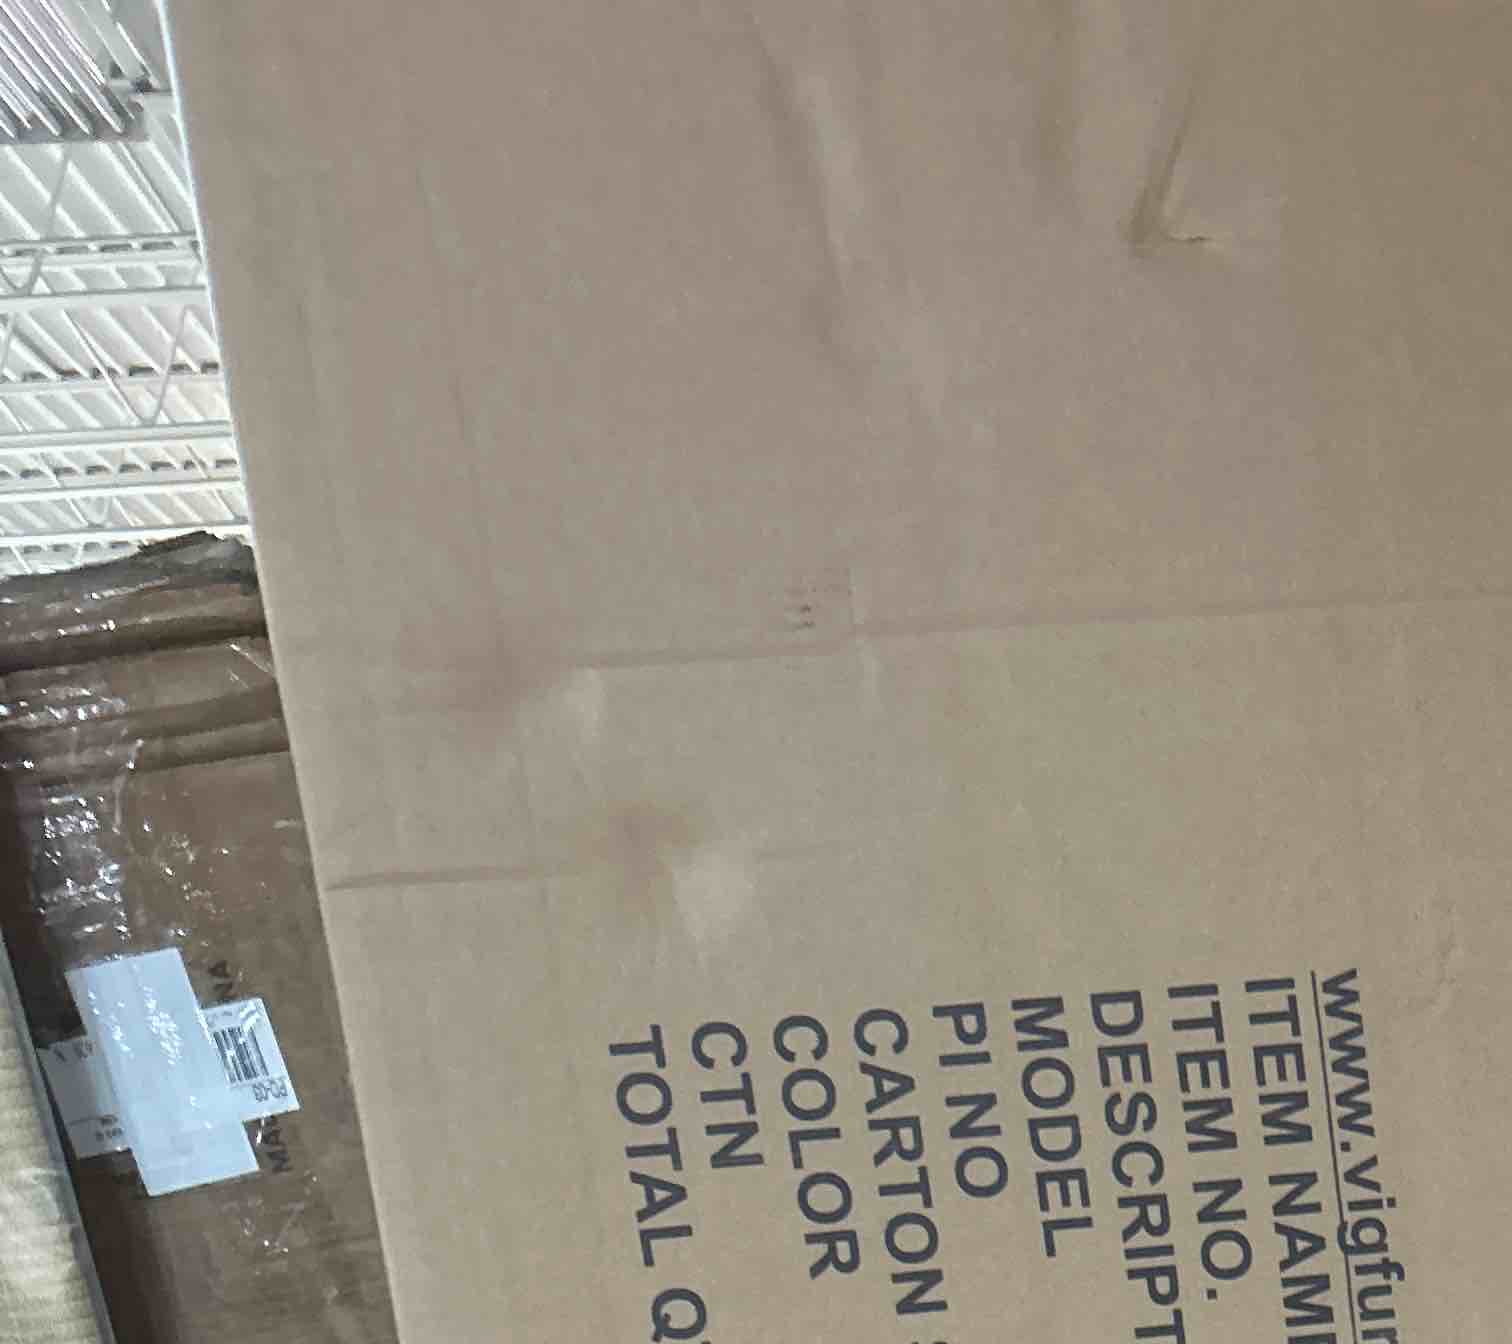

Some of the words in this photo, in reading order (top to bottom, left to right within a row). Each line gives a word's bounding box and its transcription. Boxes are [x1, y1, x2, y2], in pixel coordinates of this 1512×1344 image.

[691, 1021, 767, 1169] CTN
[932, 1002, 992, 1067] PI
[1167, 984, 1239, 1154] ITEM
[1244, 977, 1314, 1147] ITEM
[608, 1024, 693, 1268] TOTAL
[773, 1015, 861, 1280] COLOR
[853, 1008, 948, 1315] CARTON
[944, 1092, 1008, 1198] NO
[1011, 995, 1094, 1258] MODEL
[1192, 1177, 1253, 1300] NO.
